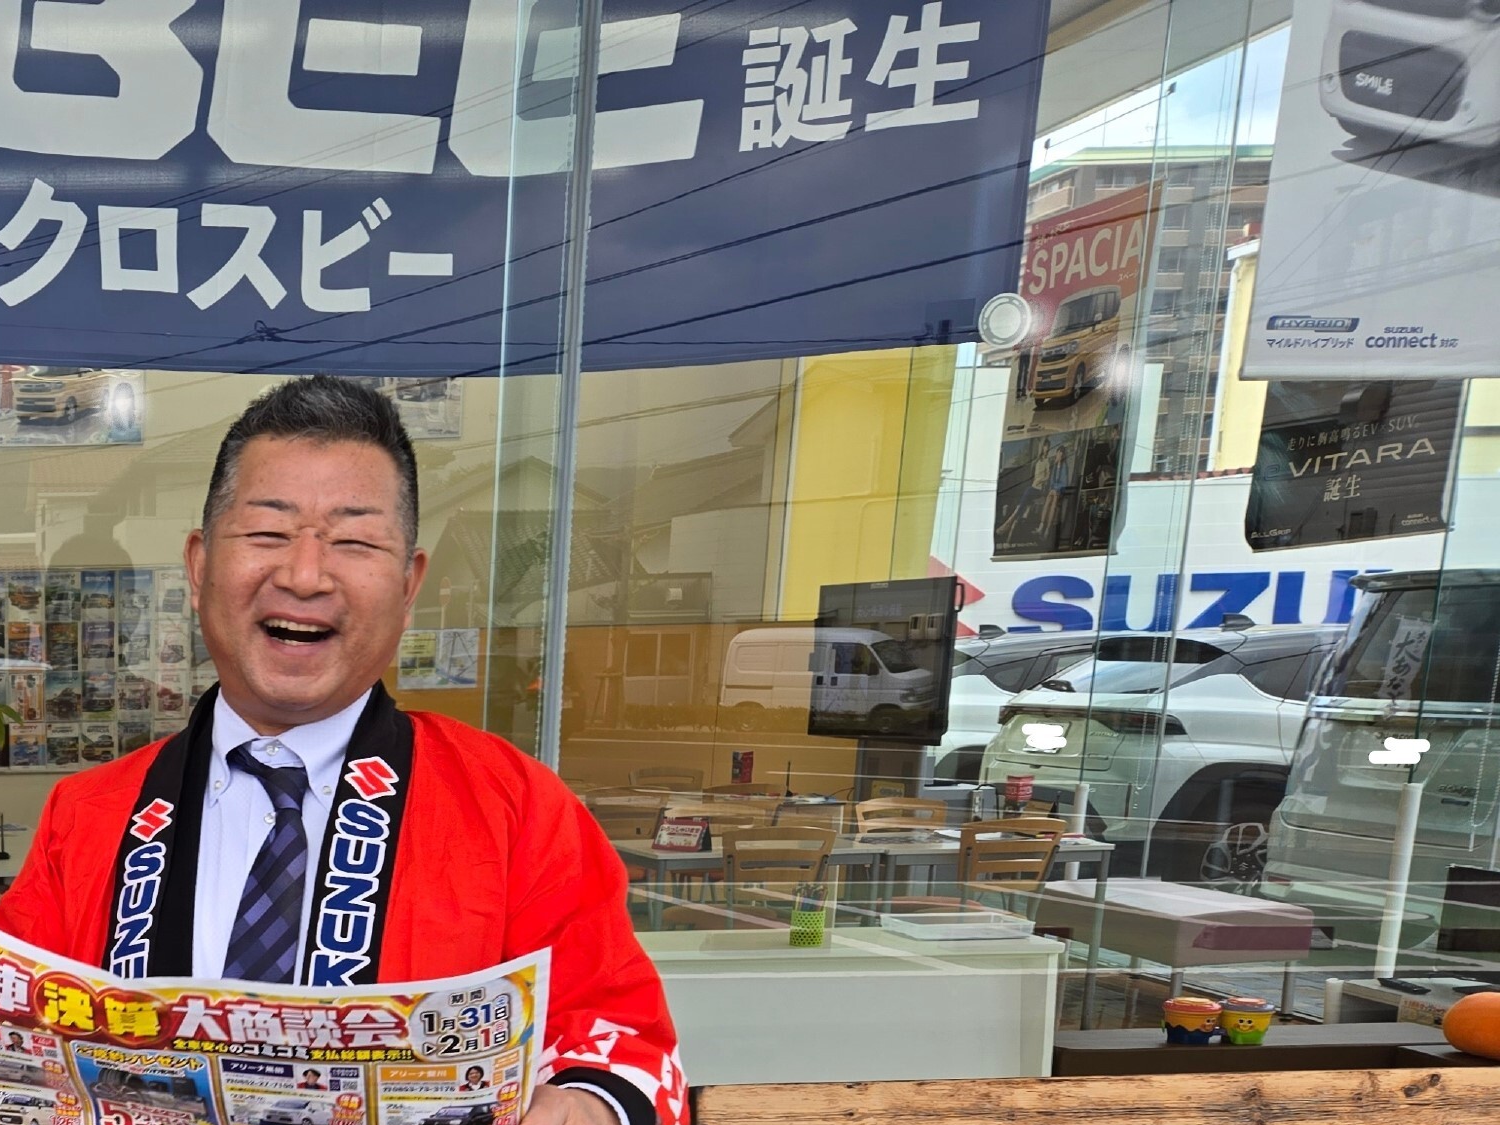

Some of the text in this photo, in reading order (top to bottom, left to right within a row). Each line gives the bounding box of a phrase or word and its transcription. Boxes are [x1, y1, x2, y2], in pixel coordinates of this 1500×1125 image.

[738, 2, 981, 152] 誕生
[1029, 219, 1144, 295] SPACIA
[1279, 317, 1347, 330] HYBRID
[1266, 338, 1354, 349] マイルドハイブリッド
[1365, 333, 1438, 349] connect
[1288, 437, 1436, 478] VITARA
[1323, 474, 1361, 502] 誕生
[1011, 570, 1393, 634] SUZU
[450, 988, 485, 1005] 期間
[44, 980, 163, 1039] 決算
[172, 996, 405, 1050] 大商談会
